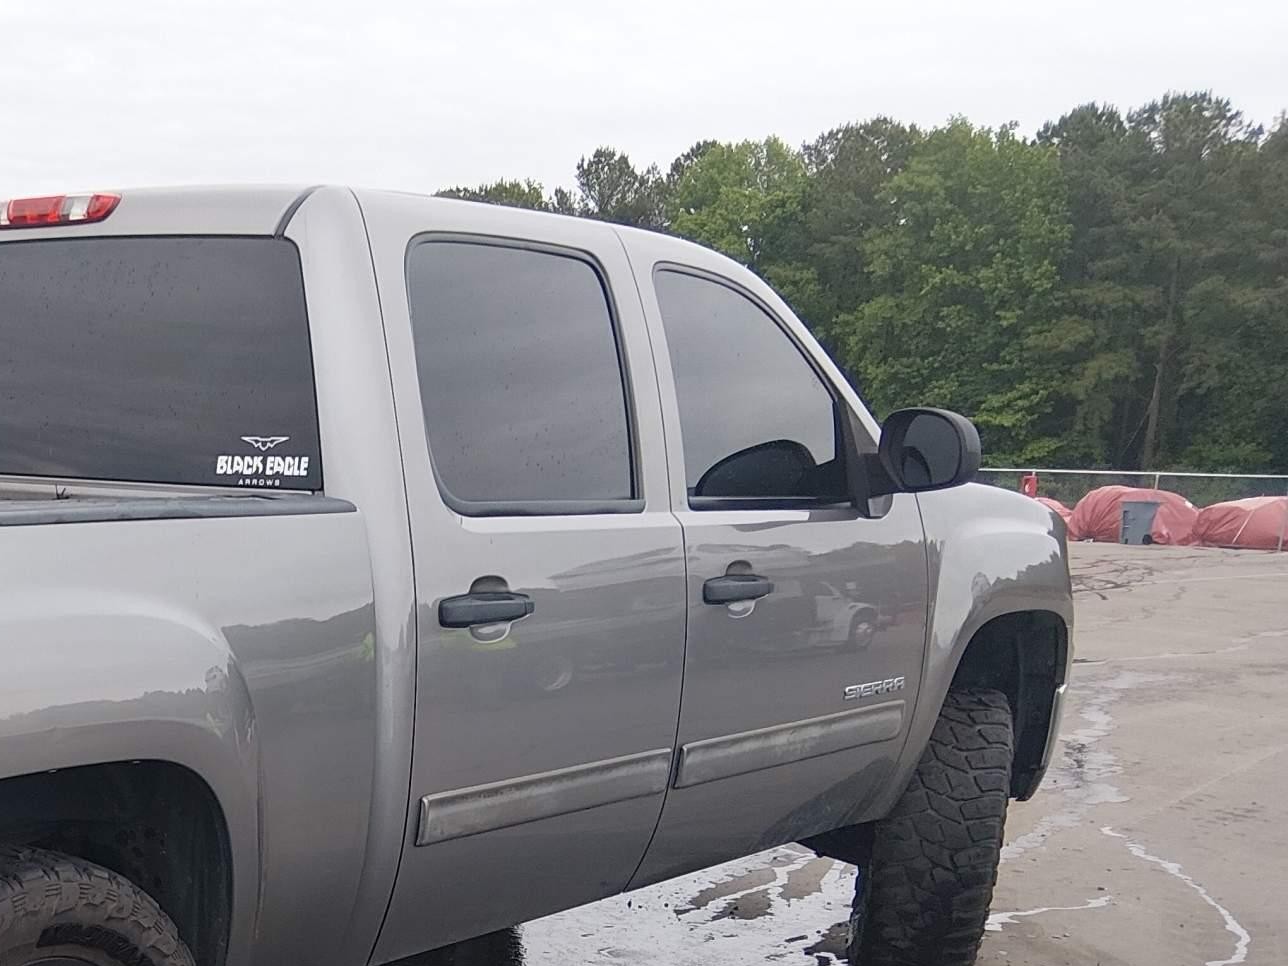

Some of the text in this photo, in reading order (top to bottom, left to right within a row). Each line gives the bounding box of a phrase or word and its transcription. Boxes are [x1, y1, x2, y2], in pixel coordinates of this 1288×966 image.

[216, 455, 309, 476] BLACK EAGLE
[843, 676, 905, 700] SIERRA
